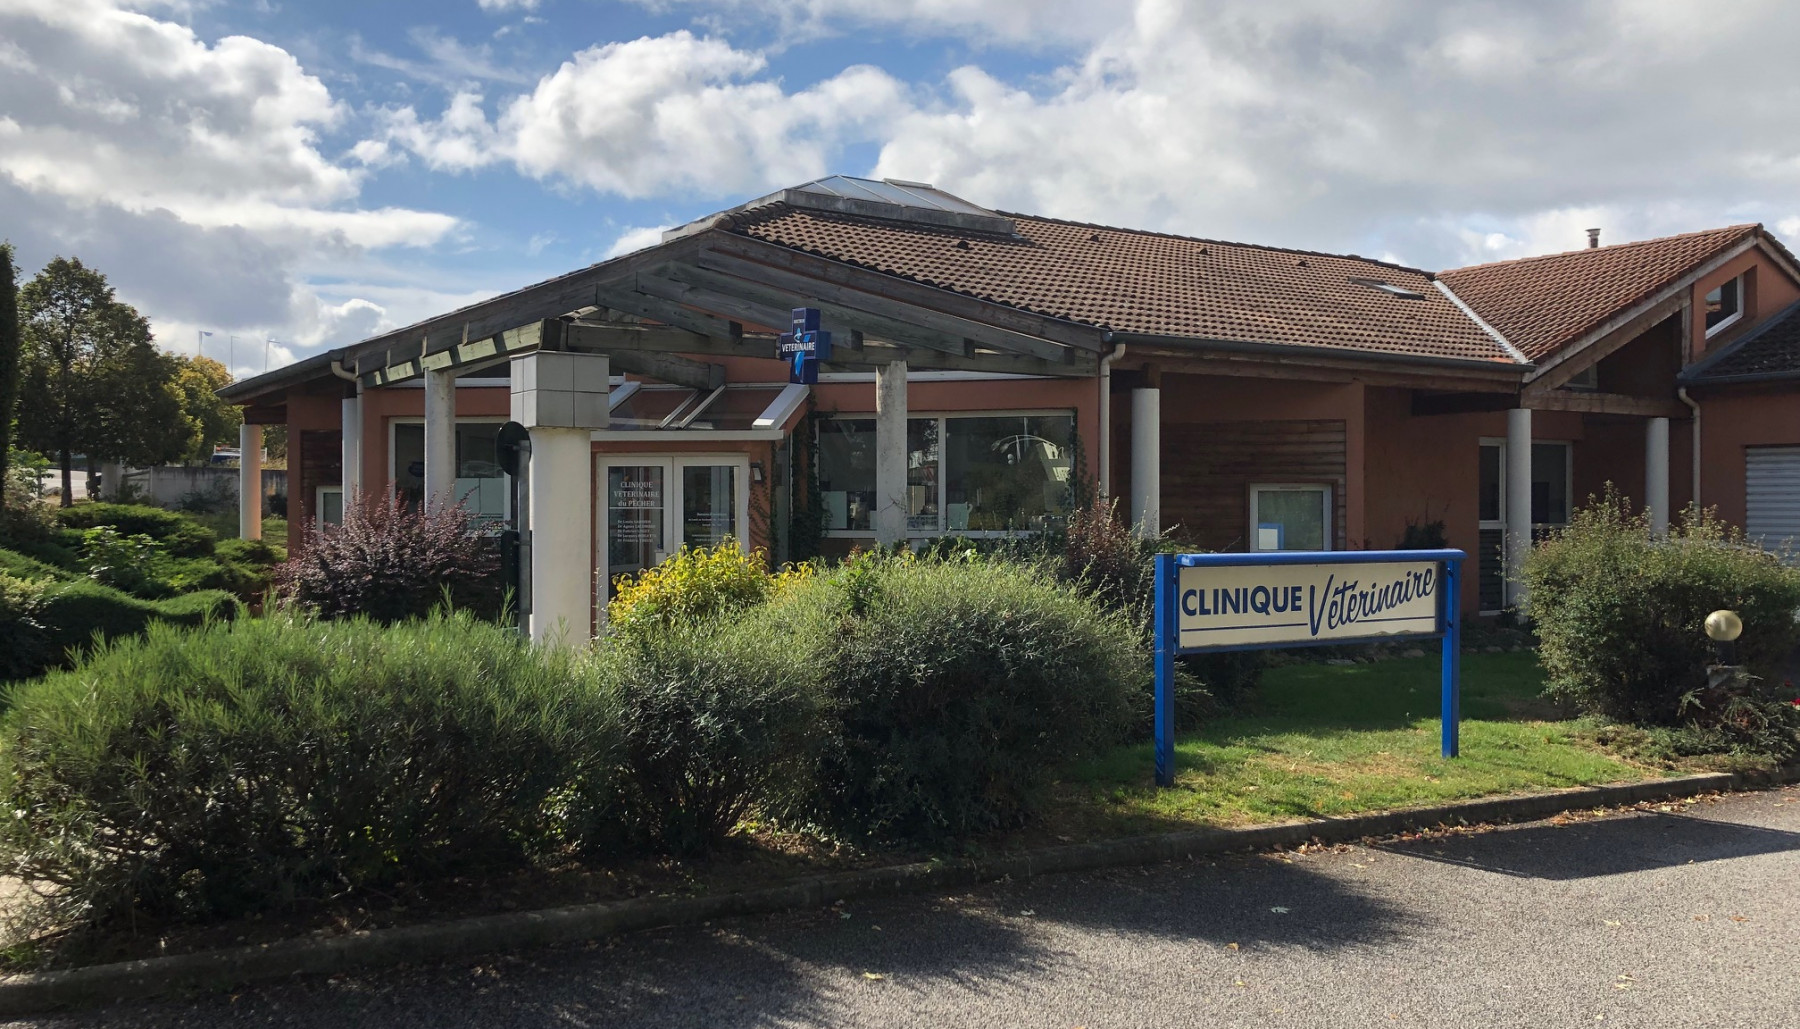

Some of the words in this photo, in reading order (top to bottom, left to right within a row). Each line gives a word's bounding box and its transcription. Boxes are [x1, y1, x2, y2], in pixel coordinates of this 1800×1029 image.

[620, 481, 654, 489] CLINIQUE
[1181, 586, 1302, 616] CLINIQUE
[1309, 567, 1436, 636] Vétérinaire
